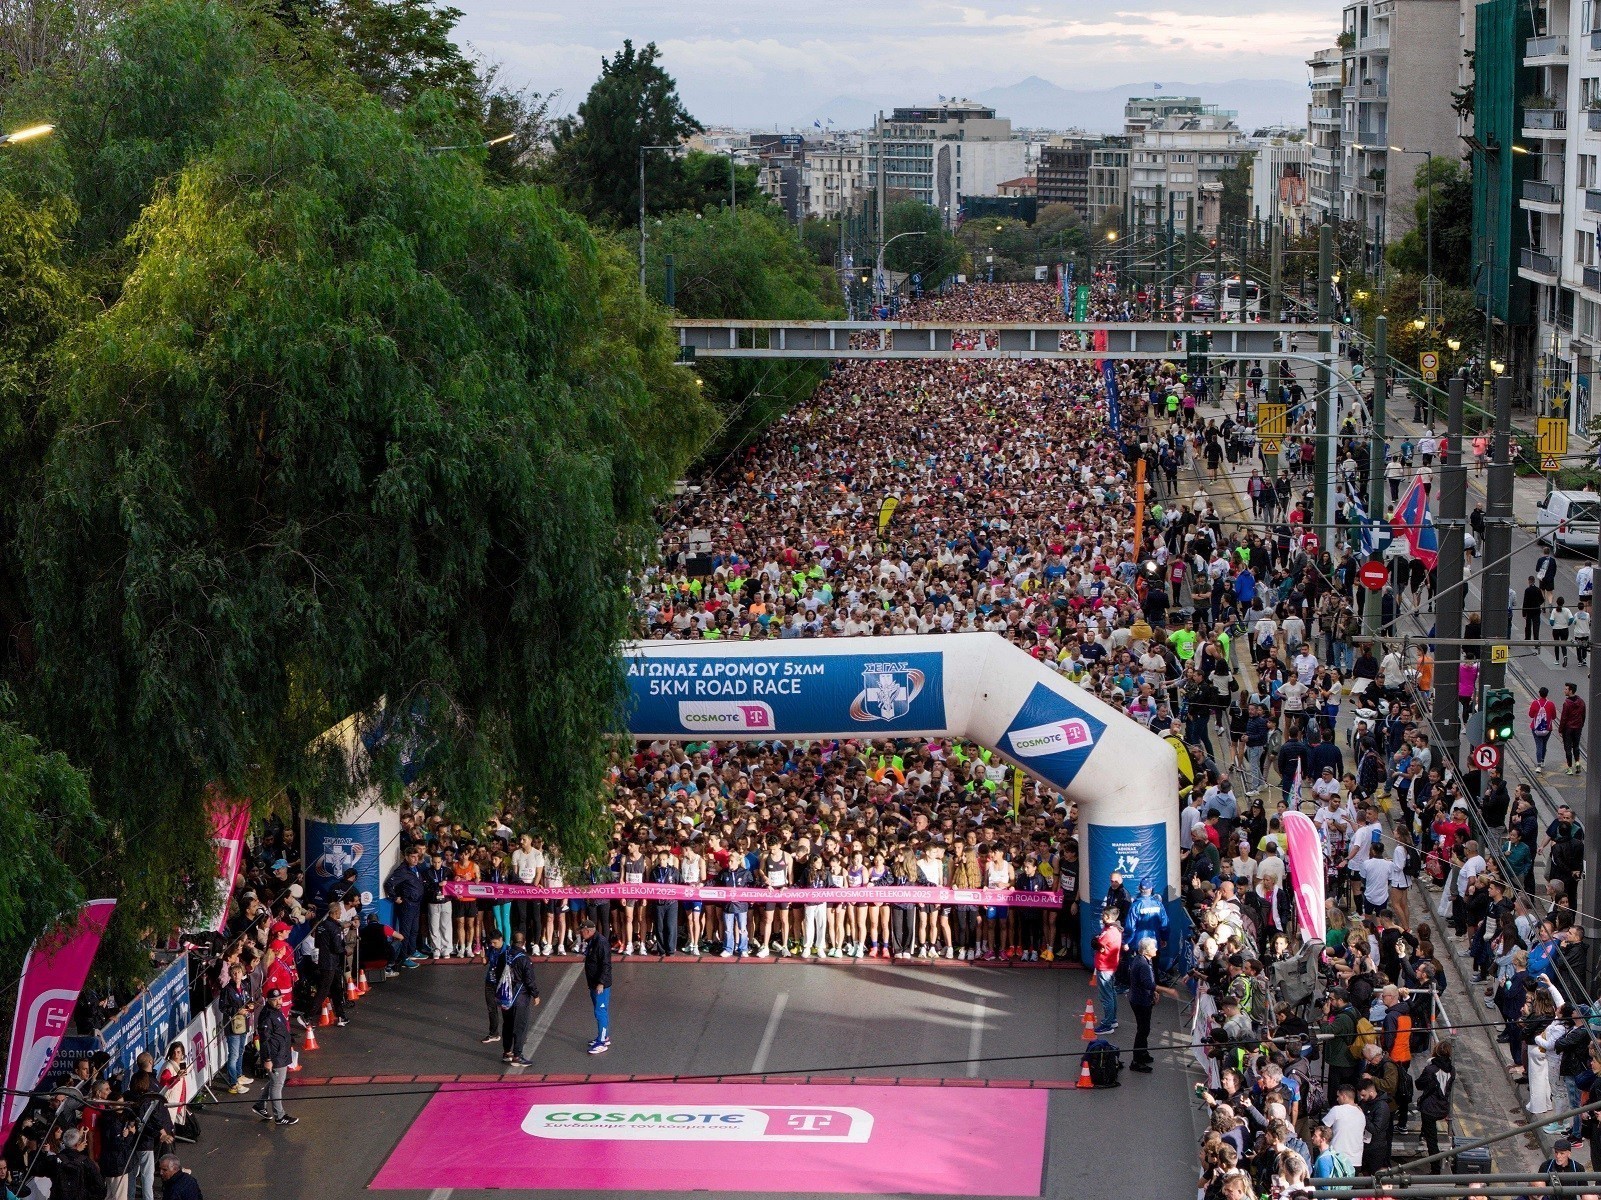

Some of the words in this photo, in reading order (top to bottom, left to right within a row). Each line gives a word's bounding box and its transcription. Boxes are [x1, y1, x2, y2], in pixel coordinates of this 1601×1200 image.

[1495, 650, 1505, 659] 50
[627, 663, 698, 677] ΑΓΩΝΑΣ
[702, 662, 779, 677] ΔΡΟΜΟΥ
[863, 662, 909, 673] ΣΕΓΑΣ
[650, 680, 689, 696] 5KM
[695, 680, 747, 695] ROAD
[753, 678, 802, 695] RACE
[685, 714, 740, 722] COSMOTE
[1016, 734, 1062, 749] COSMOTE
[509, 885, 526, 895] 5km
[526, 885, 549, 895] ROAD
[551, 885, 574, 895] RACE
[616, 885, 655, 895] TELEKOM
[656, 886, 676, 896] 2025
[835, 891, 874, 899] COSMOTE
[875, 890, 911, 899] TELEKOM
[912, 890, 931, 898] 2025
[997, 894, 1014, 902] 5km
[1015, 894, 1040, 903] ROAD
[1041, 895, 1064, 904] RACE
[545, 1112, 745, 1123] COSMOTE
